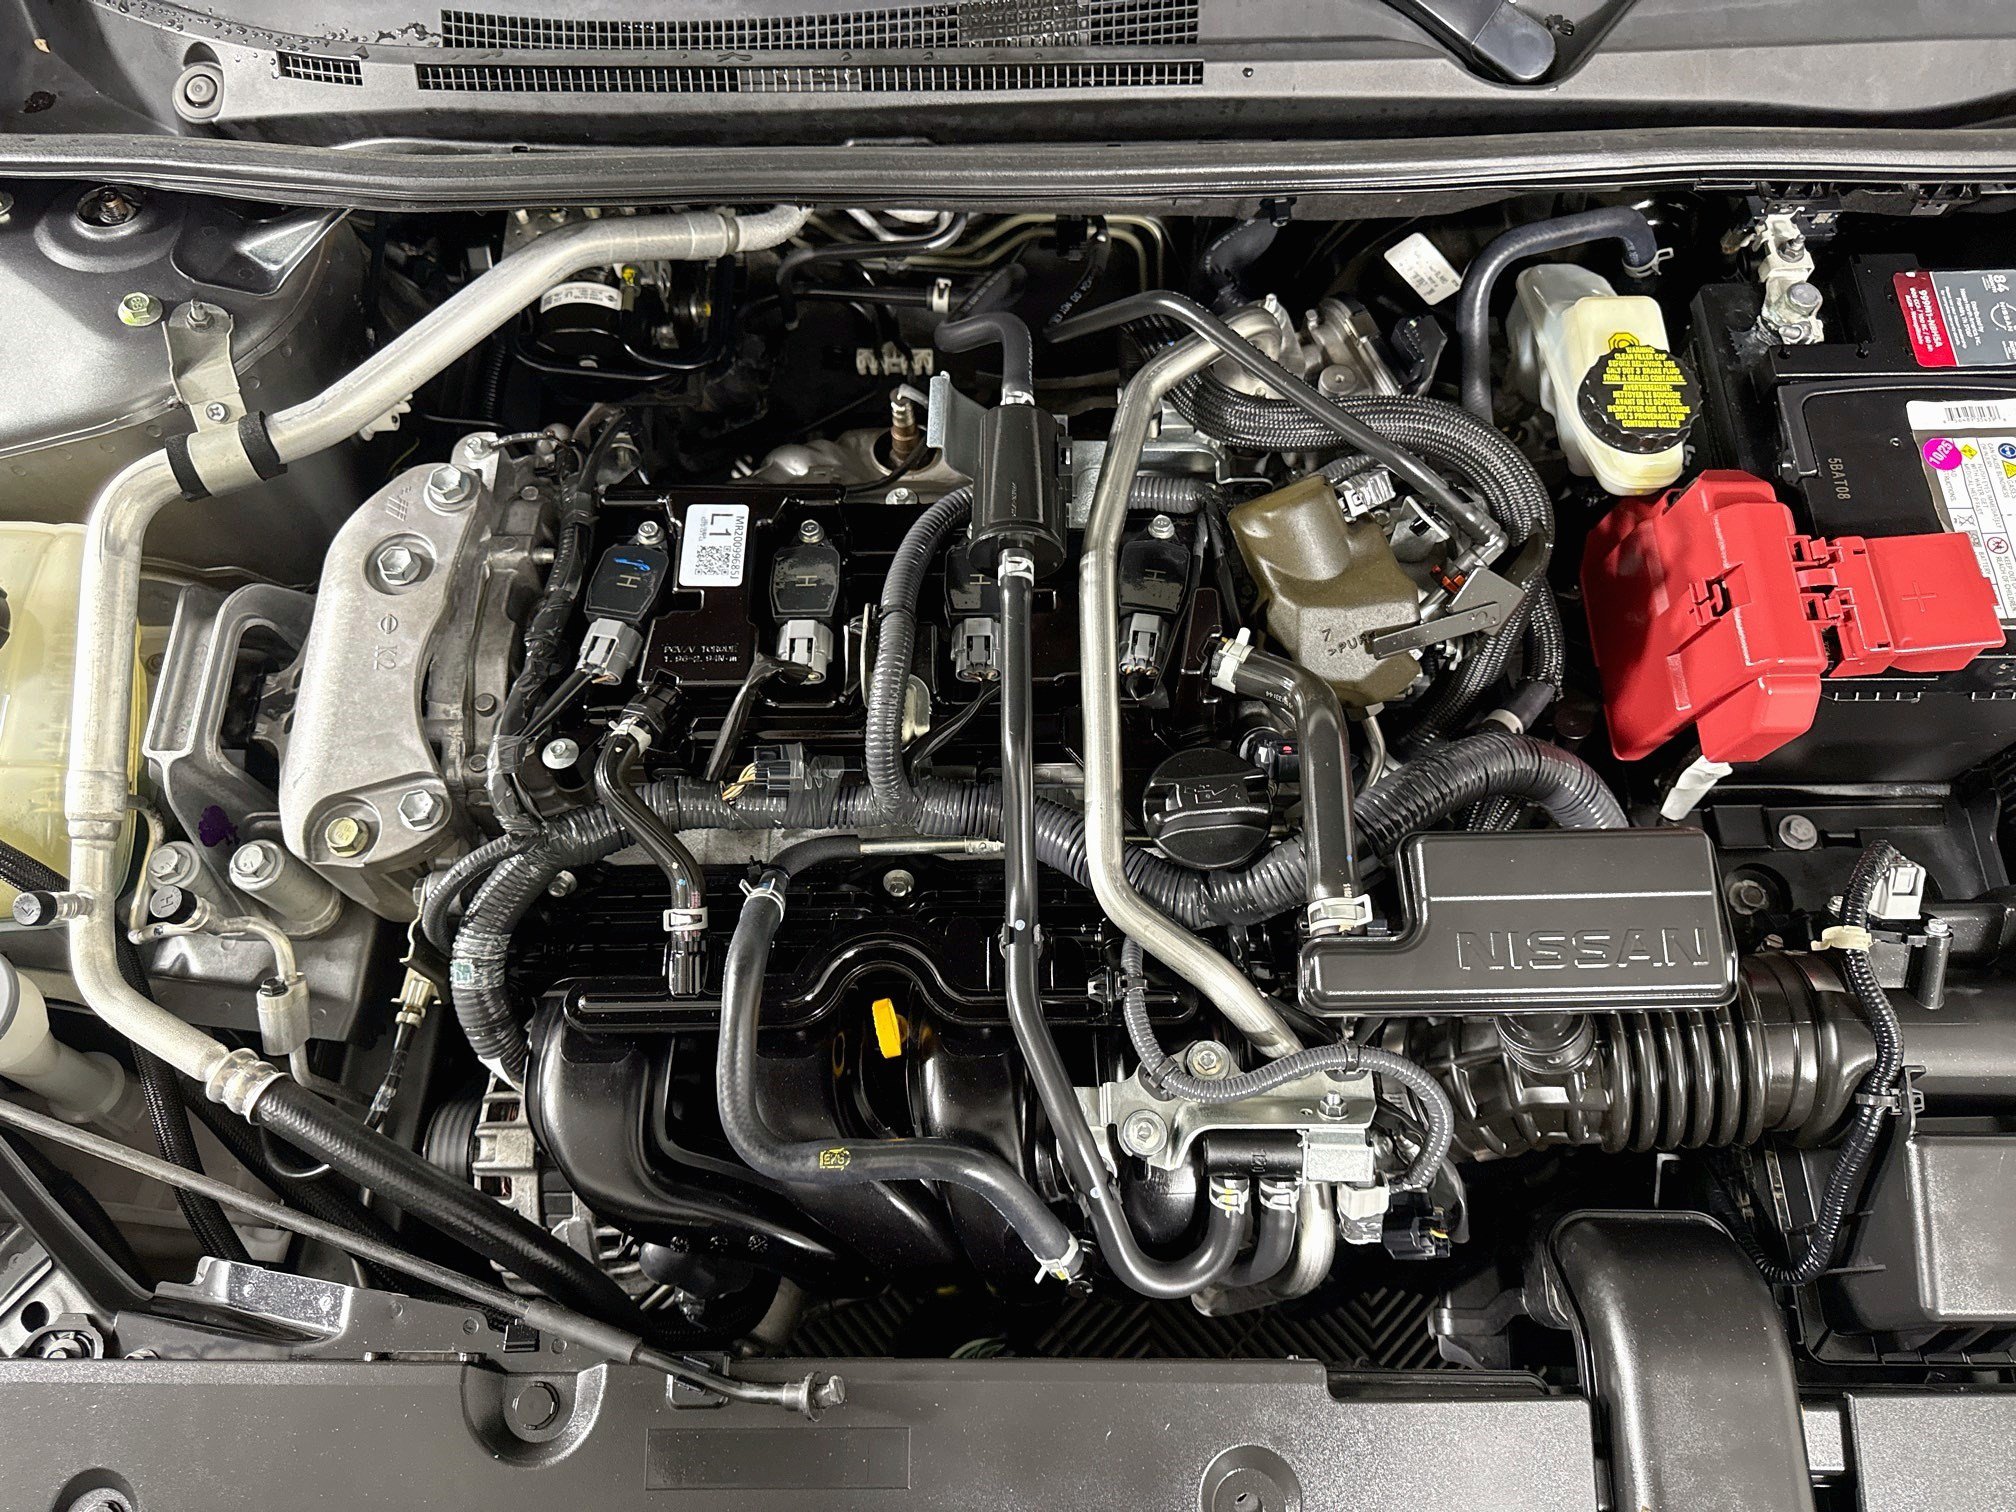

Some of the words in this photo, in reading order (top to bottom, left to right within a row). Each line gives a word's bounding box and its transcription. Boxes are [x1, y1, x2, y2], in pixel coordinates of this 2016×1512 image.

[1992, 274, 2010, 292] 84
[1998, 301, 2014, 331] NISSAN
[1928, 440, 1953, 465] 10/25
[1827, 457, 1851, 499] 5BAT08
[1981, 480, 1991, 493] EYES
[709, 513, 734, 537] L1
[730, 515, 745, 580] MR20099685J
[1978, 551, 1991, 574] BATTERY
[1995, 556, 2006, 572] REACH
[2002, 556, 2012, 570] KEEP
[2008, 572, 2016, 582] OUT
[1456, 927, 1710, 972] NISSAN
